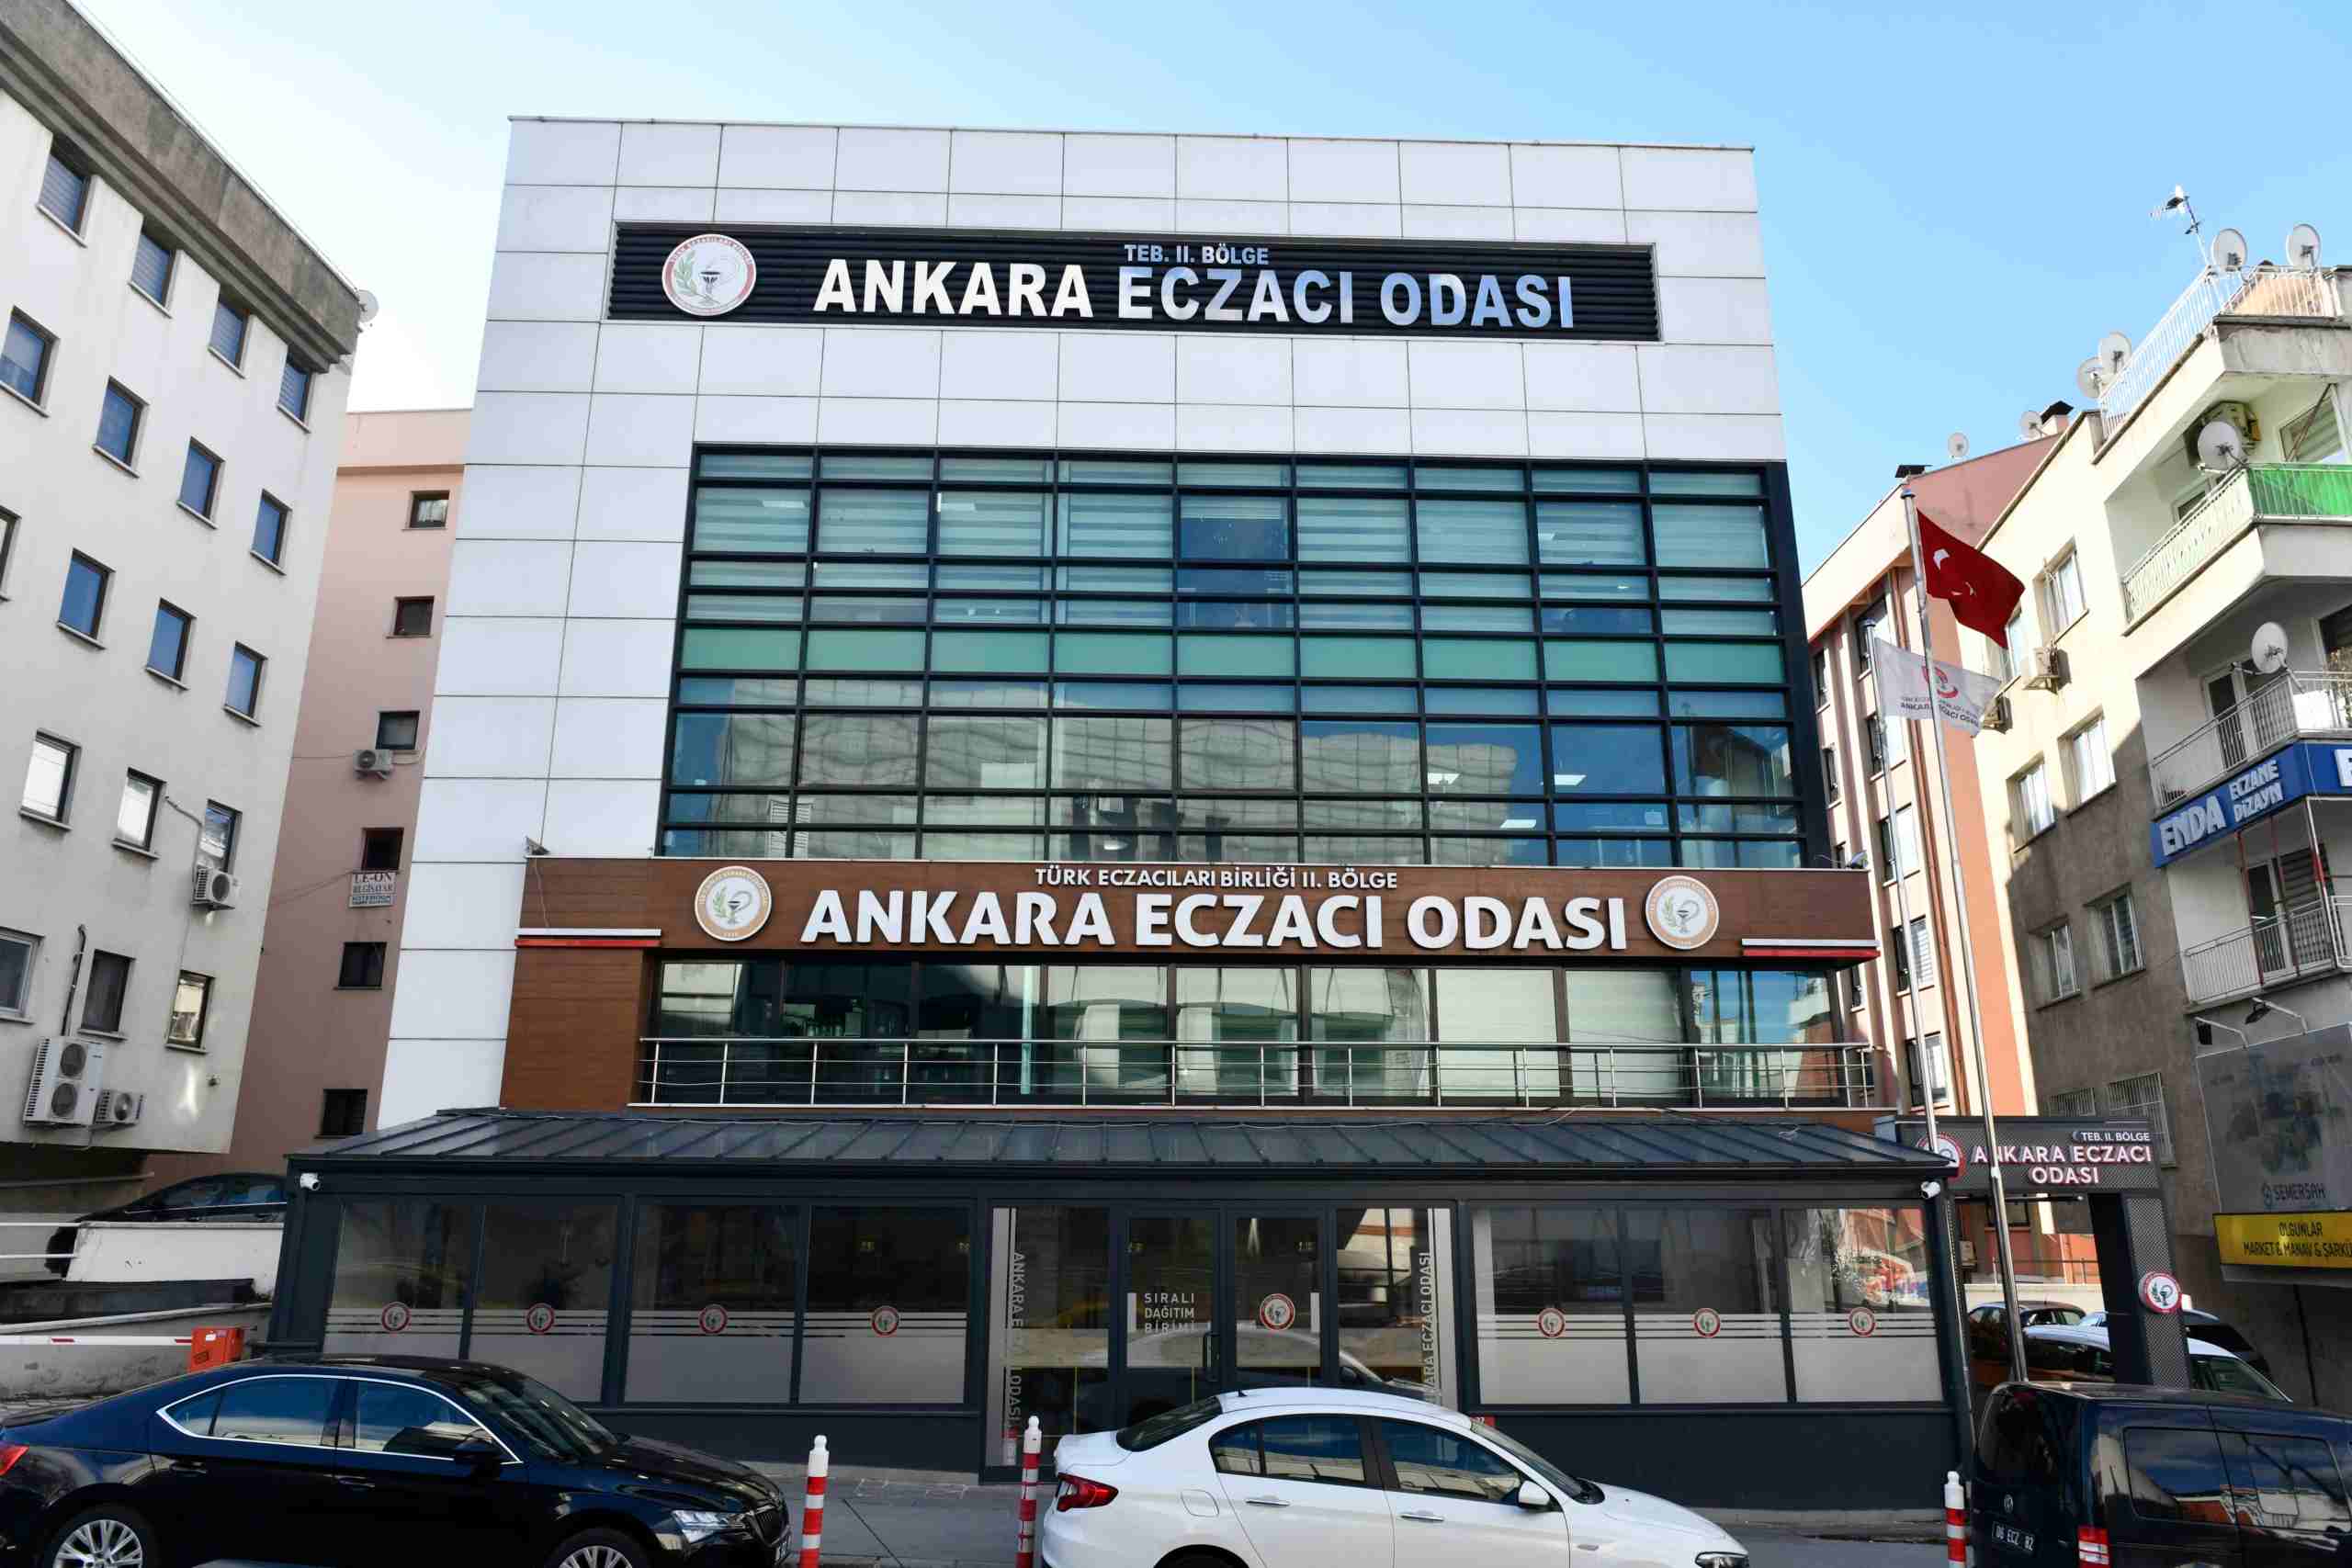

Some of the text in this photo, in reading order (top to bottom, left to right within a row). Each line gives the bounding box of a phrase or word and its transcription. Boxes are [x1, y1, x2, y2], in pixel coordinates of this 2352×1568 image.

[1125, 243, 1269, 265] TEB. II. BÖLGE
[814, 258, 1575, 328] ANKARA ECZACI ODASI
[2159, 760, 2278, 856] ENDA ECZANE
[1035, 866, 1397, 889] TÜRK ECZACILARI BİRLİĞİ II. BÖLGE
[800, 889, 1117, 946] ANKARA
[1135, 894, 1383, 949] ECZACI
[1407, 896, 1627, 952] ODASI
[2081, 1132, 2102, 1142] TEB.
[2115, 1131, 2151, 1142] BÖLGE
[2073, 1145, 2152, 1163] ECZACI
[2031, 1167, 2099, 1184] ODASI
[1012, 1252, 1025, 1314] ANKARA
[1144, 1292, 1194, 1303] SIRALI
[1145, 1305, 1194, 1319] DAĞITIM
